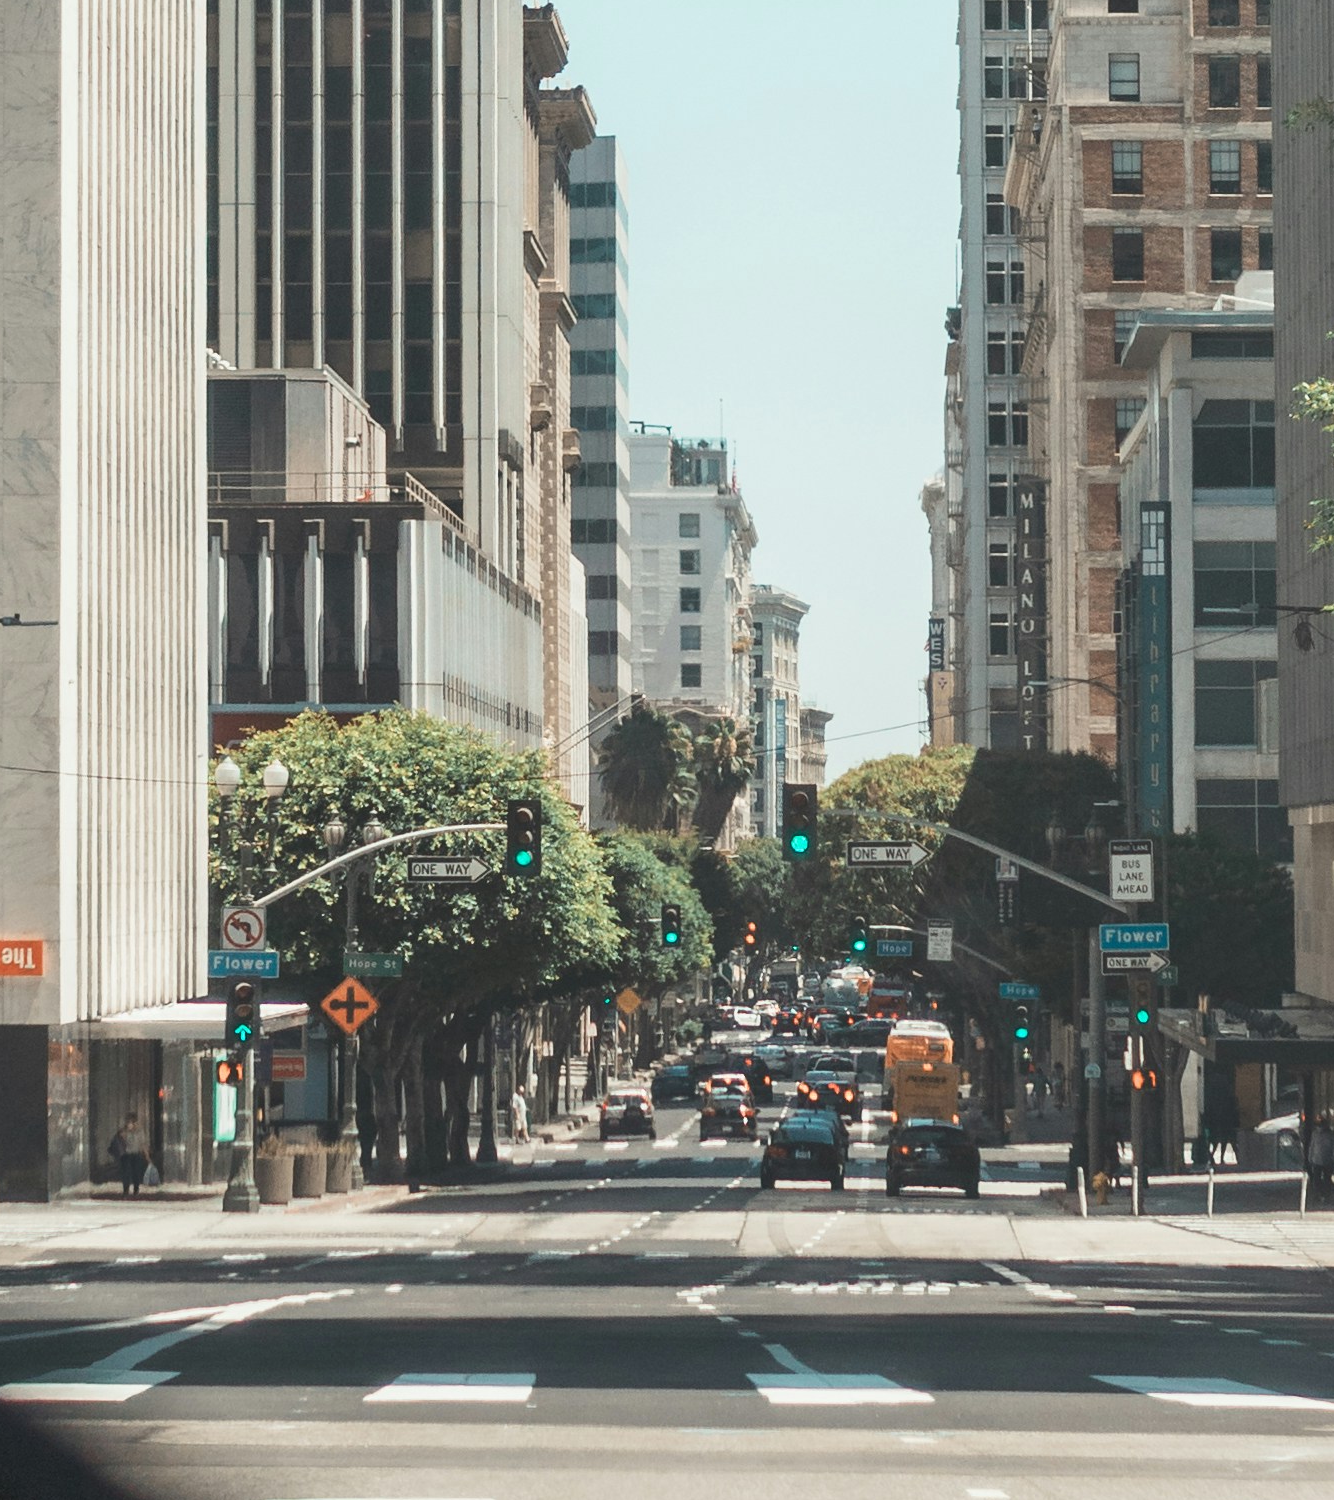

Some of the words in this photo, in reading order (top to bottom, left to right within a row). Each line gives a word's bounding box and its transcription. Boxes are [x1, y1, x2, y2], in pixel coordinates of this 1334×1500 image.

[1020, 492, 1034, 633] MILANO
[853, 848, 877, 859] ONE
[885, 848, 910, 859] WAY
[1121, 860, 1140, 868] BUS
[413, 864, 437, 875] ONE
[445, 864, 470, 875] WAY
[1119, 873, 1144, 881] LANE
[1117, 885, 1148, 893] AHEAD
[1105, 930, 1163, 942] Flower
[882, 944, 907, 953] Hope
[1, 947, 36, 969] The
[213, 956, 273, 970] Flower
[1109, 959, 1128, 967] ONE
[1130, 959, 1149, 967] WAY
[349, 960, 377, 970] Hope
[384, 960, 397, 969] St
